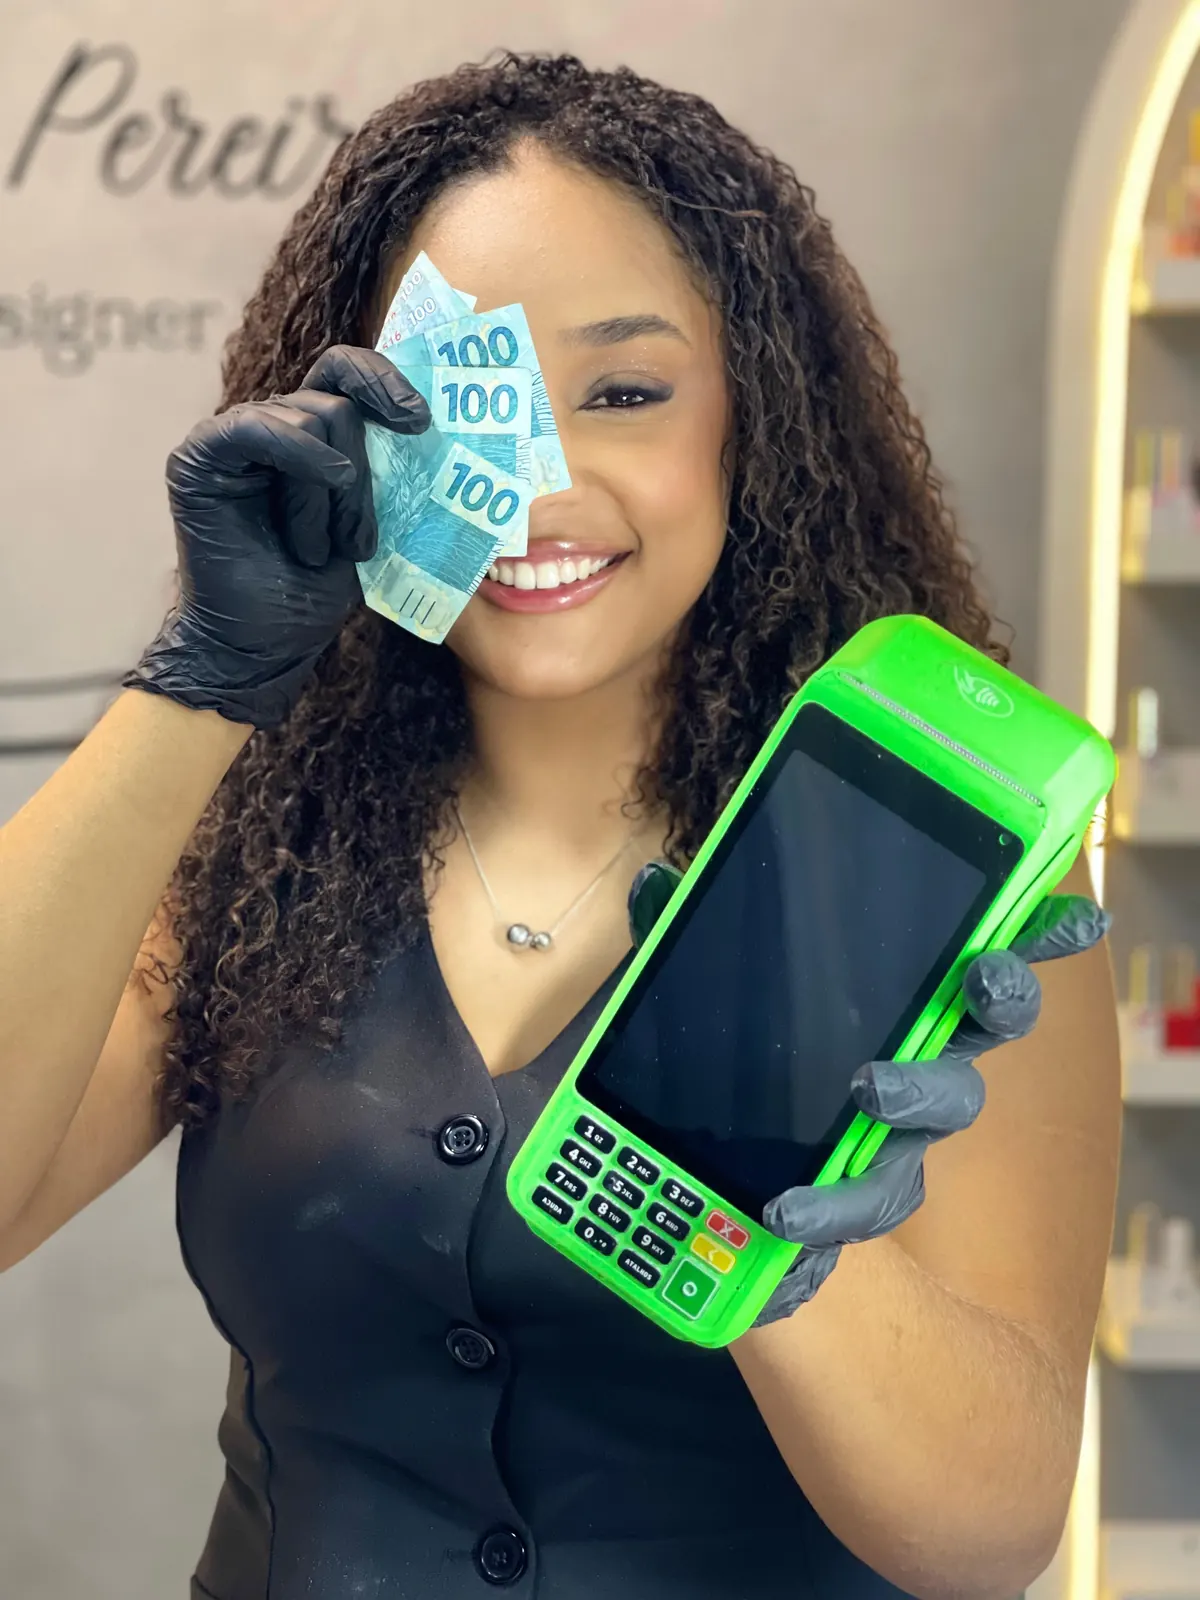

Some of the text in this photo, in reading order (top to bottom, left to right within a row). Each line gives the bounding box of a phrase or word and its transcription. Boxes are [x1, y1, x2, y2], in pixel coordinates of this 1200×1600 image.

[407, 297, 436, 326] 100
[437, 326, 519, 368] 100
[441, 383, 519, 424] 100
[445, 462, 520, 526] 100
[584, 1125, 595, 1138] 1
[568, 1148, 580, 1161] 4
[626, 1155, 651, 1178] 2 ABC
[554, 1170, 566, 1183] 7
[612, 1180, 624, 1192] 5
[669, 1184, 681, 1199] 3
[541, 1196, 563, 1215] AJUDA
[597, 1202, 621, 1224] 8 TUV
[655, 1211, 667, 1223] 6
[584, 1226, 595, 1239] 0
[640, 1234, 652, 1246] 9
[624, 1258, 653, 1281] ATALHOS
